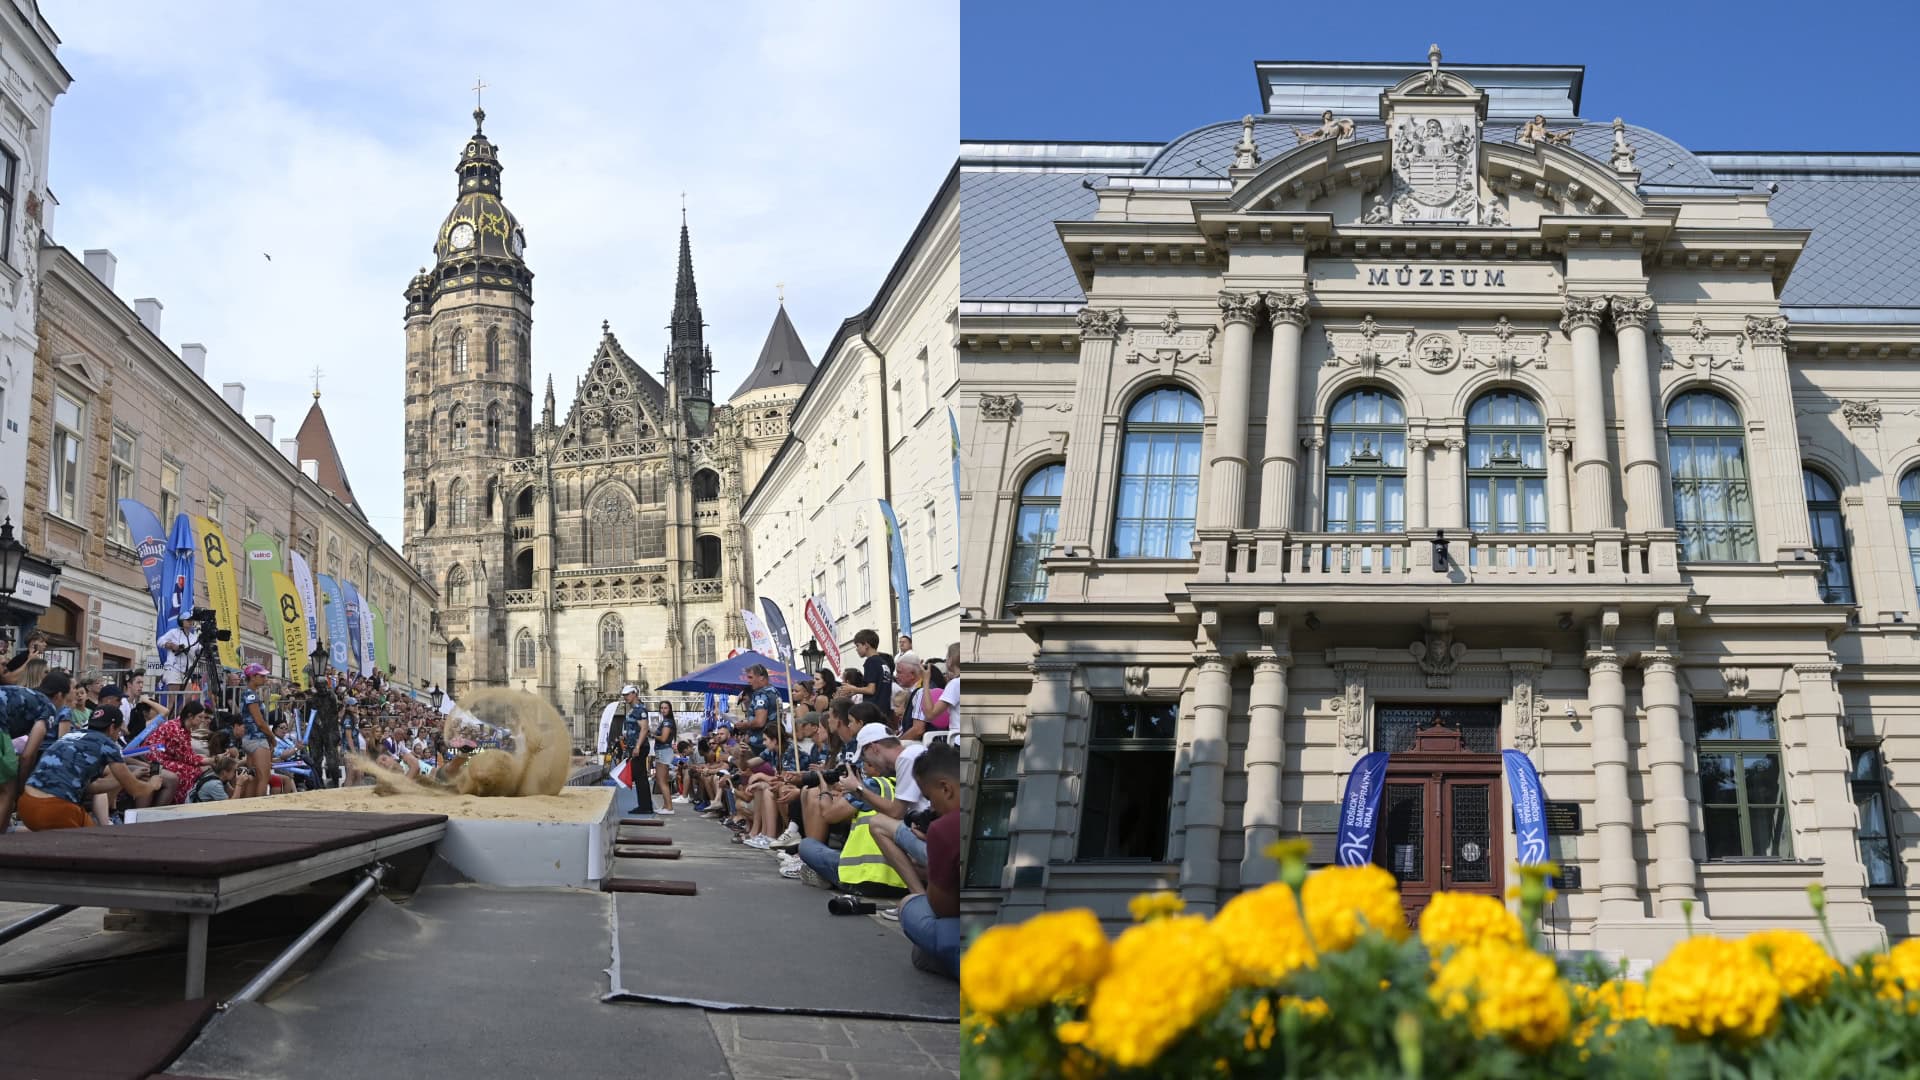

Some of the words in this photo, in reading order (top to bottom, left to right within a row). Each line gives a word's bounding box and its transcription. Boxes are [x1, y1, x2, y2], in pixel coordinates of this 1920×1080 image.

[1368, 264, 1506, 287] MÚZEUM
[1346, 791, 1359, 827] KOŠICKÝ
[1355, 769, 1372, 828] SAMOSPRÁVNY
[1363, 807, 1375, 829] KRAJ
